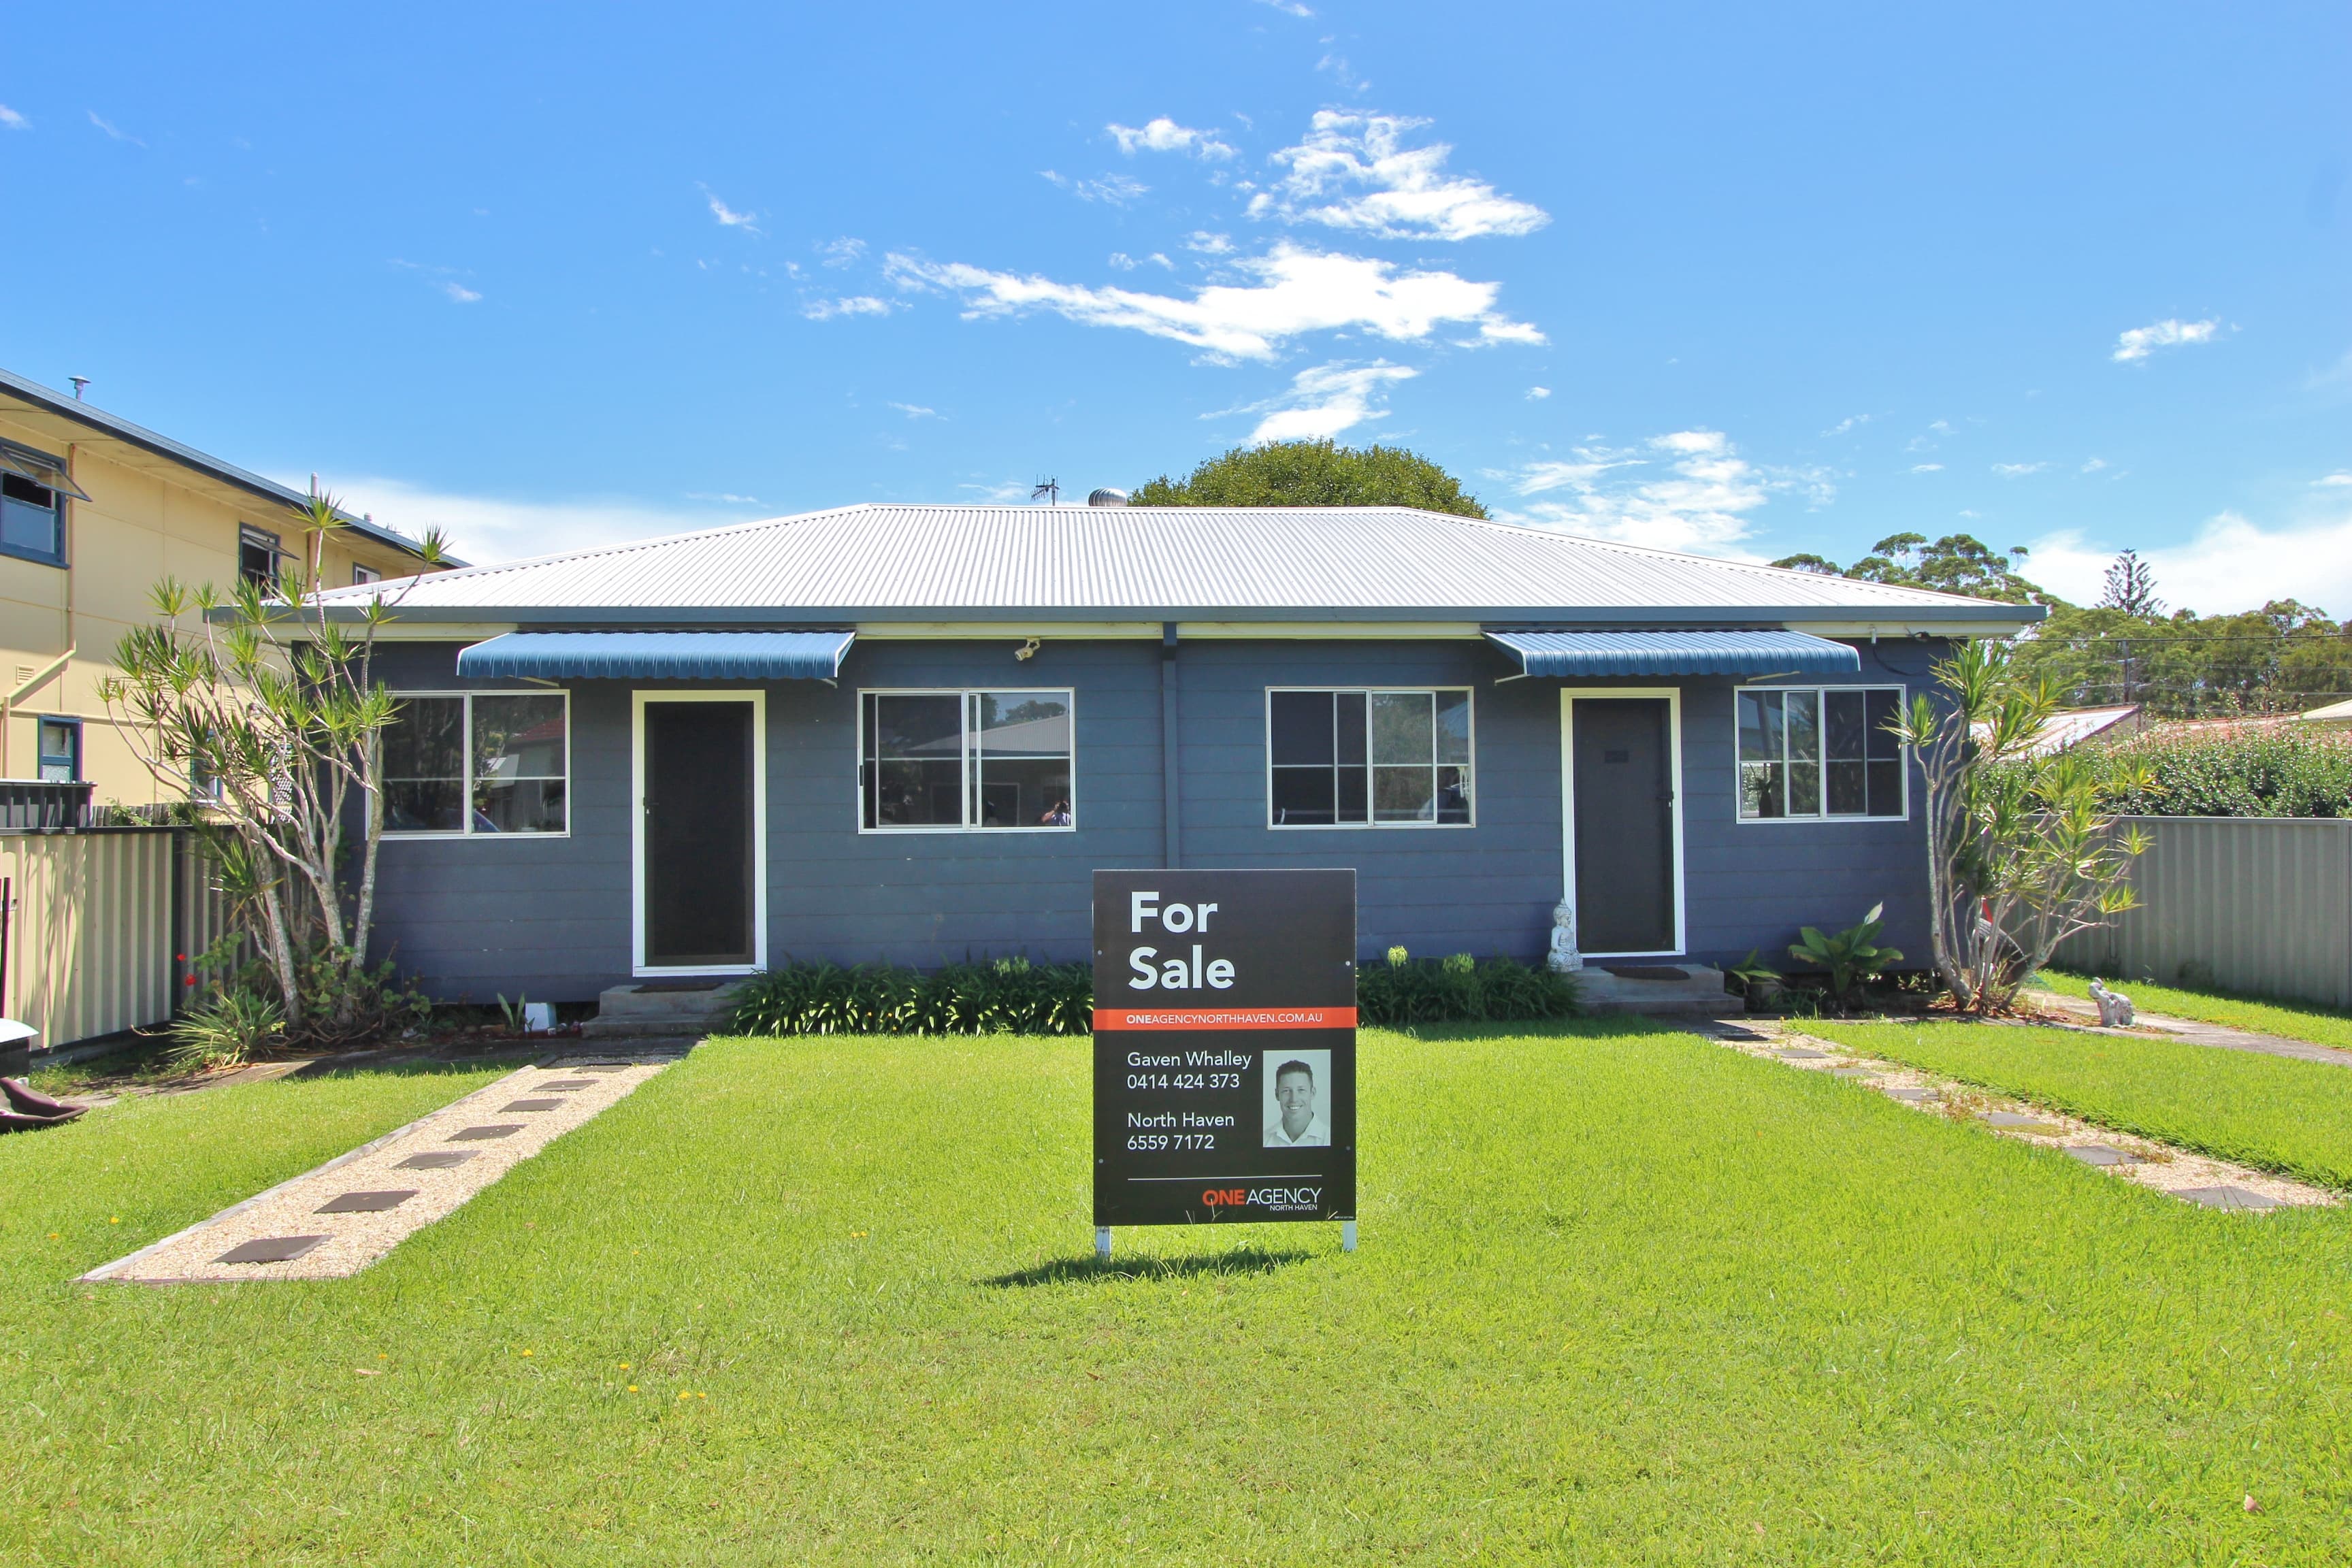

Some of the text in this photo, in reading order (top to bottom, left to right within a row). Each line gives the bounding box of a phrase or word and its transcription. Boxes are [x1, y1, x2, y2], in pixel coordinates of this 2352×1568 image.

[1131, 891, 1218, 934] For
[1128, 944, 1235, 990] Sale
[1126, 1013, 1322, 1024] ONEAGENCYNORTHHAVEN.COM.AU
[1127, 1049, 1252, 1071] Gaven Whalley
[1127, 1073, 1240, 1090] 0414 424 373
[1128, 1111, 1235, 1128] North Haven
[1127, 1134, 1215, 1150] 6559 7172
